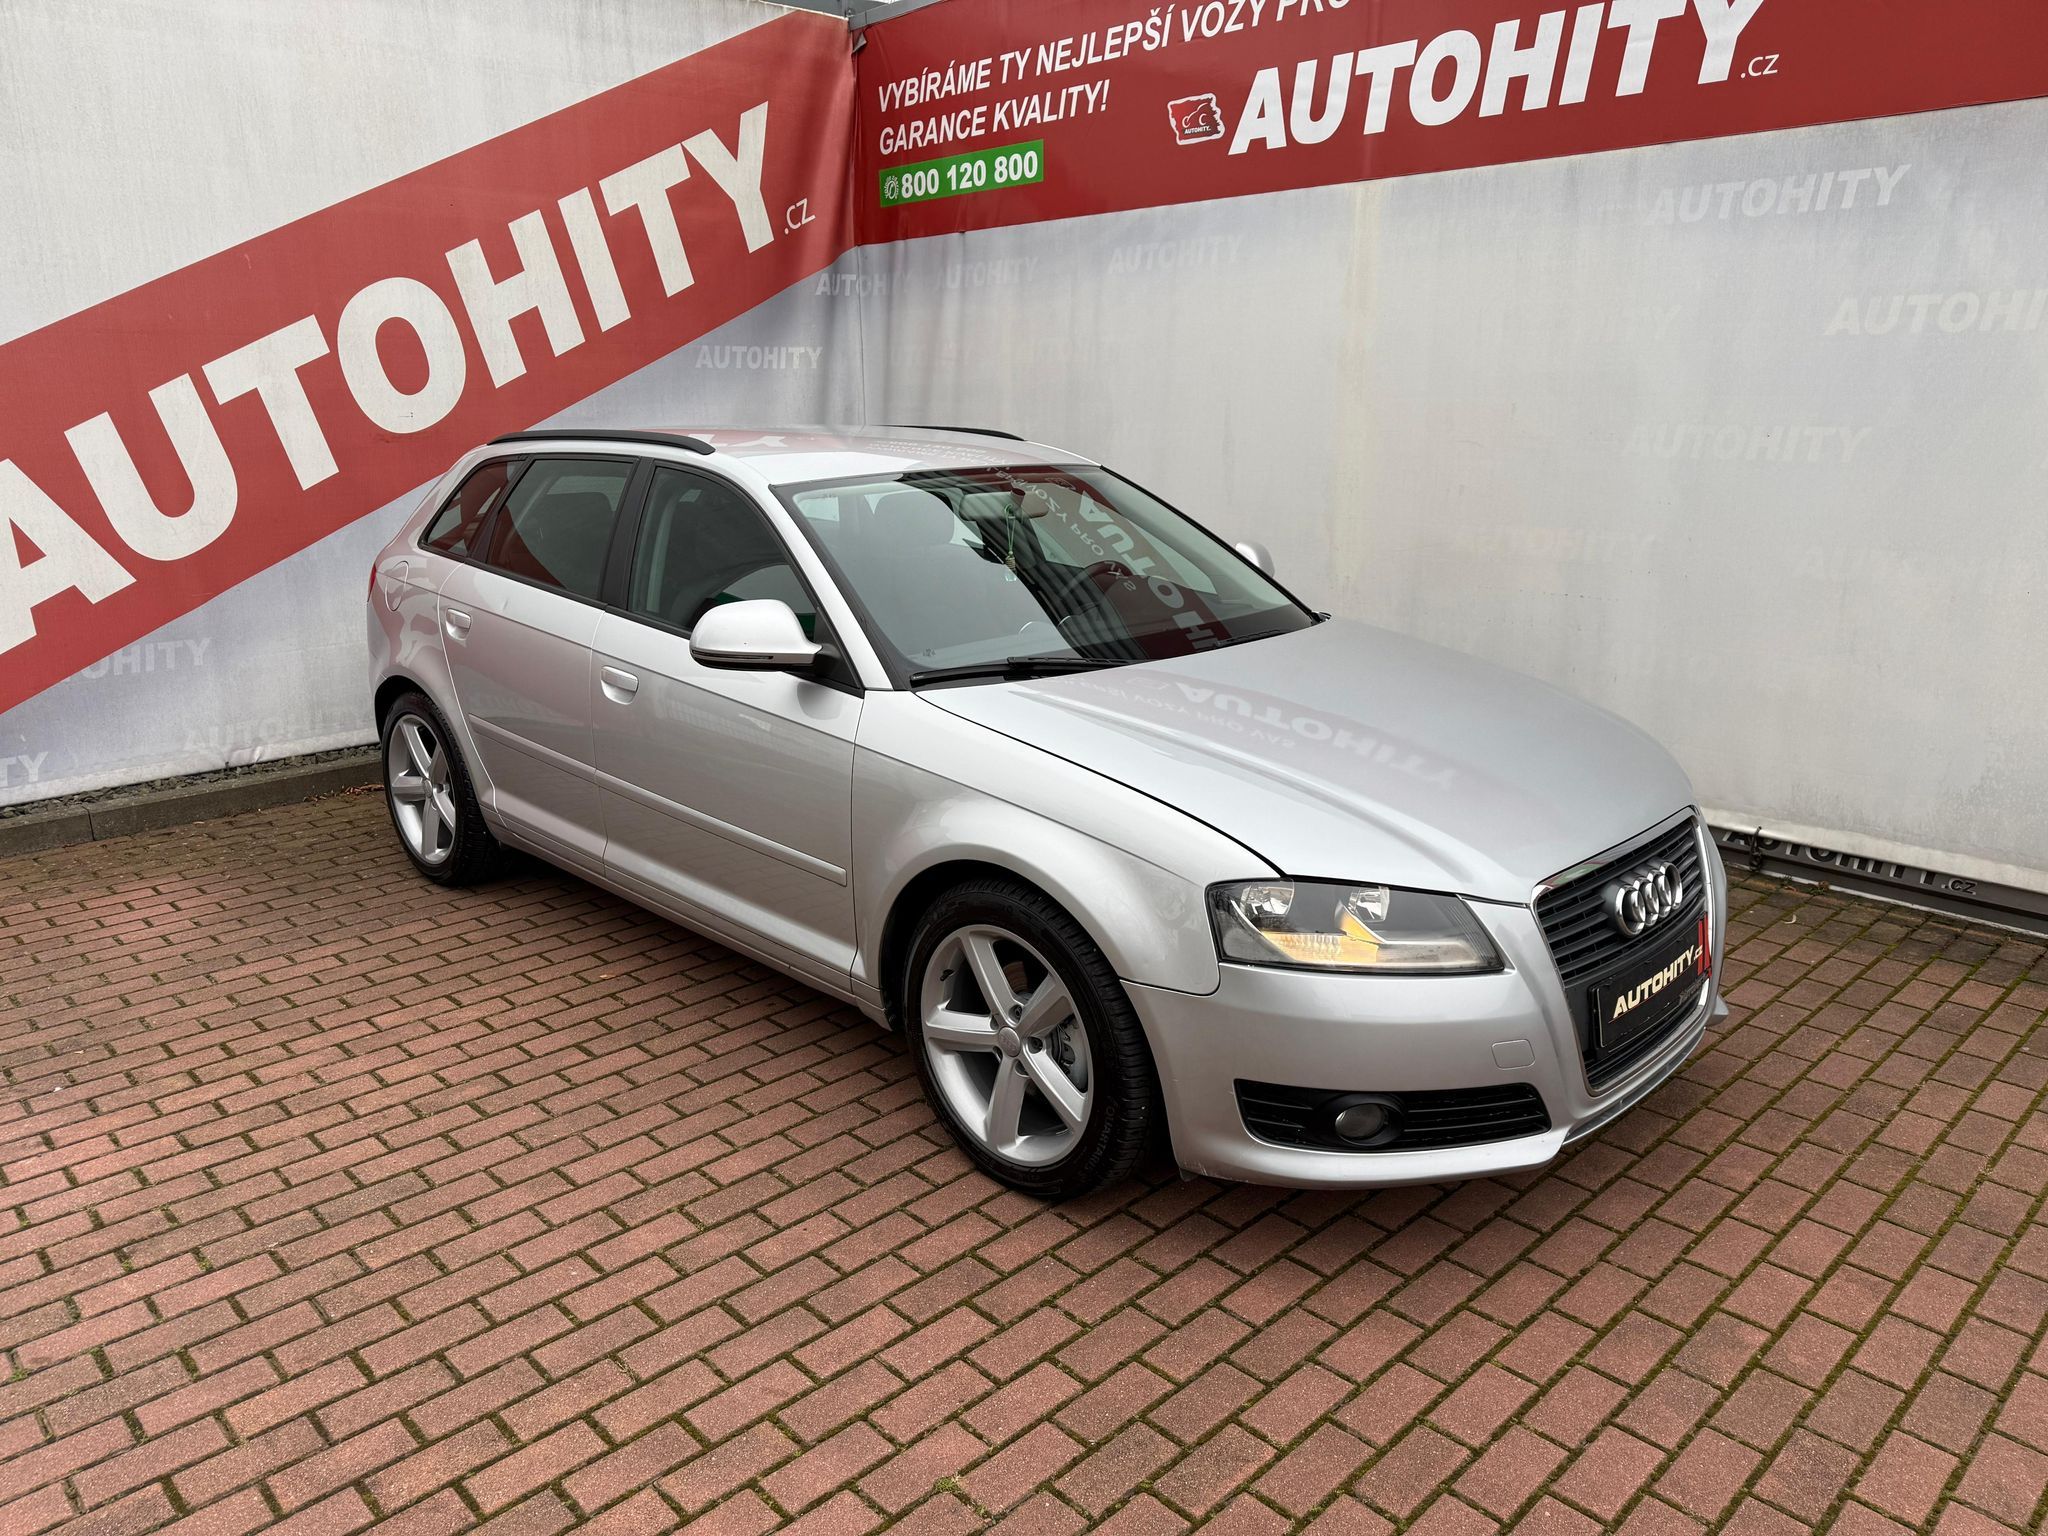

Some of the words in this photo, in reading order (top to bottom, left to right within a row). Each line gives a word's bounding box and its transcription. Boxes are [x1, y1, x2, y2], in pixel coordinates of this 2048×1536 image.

[878, 56, 993, 114] VYBÍRÁME
[999, 47, 1030, 83] TY
[1036, 6, 1174, 76] NEJLEPŠÍ
[1181, 0, 1266, 43] VOZY
[879, 106, 986, 156] GARANCE
[993, 79, 1110, 133] KVALITY!
[901, 168, 940, 199] 800
[946, 160, 987, 191] 120
[994, 150, 1038, 183] 800
[1645, 163, 1912, 227] AUTOHITY
[694, 344, 823, 369] AUTOHITY
